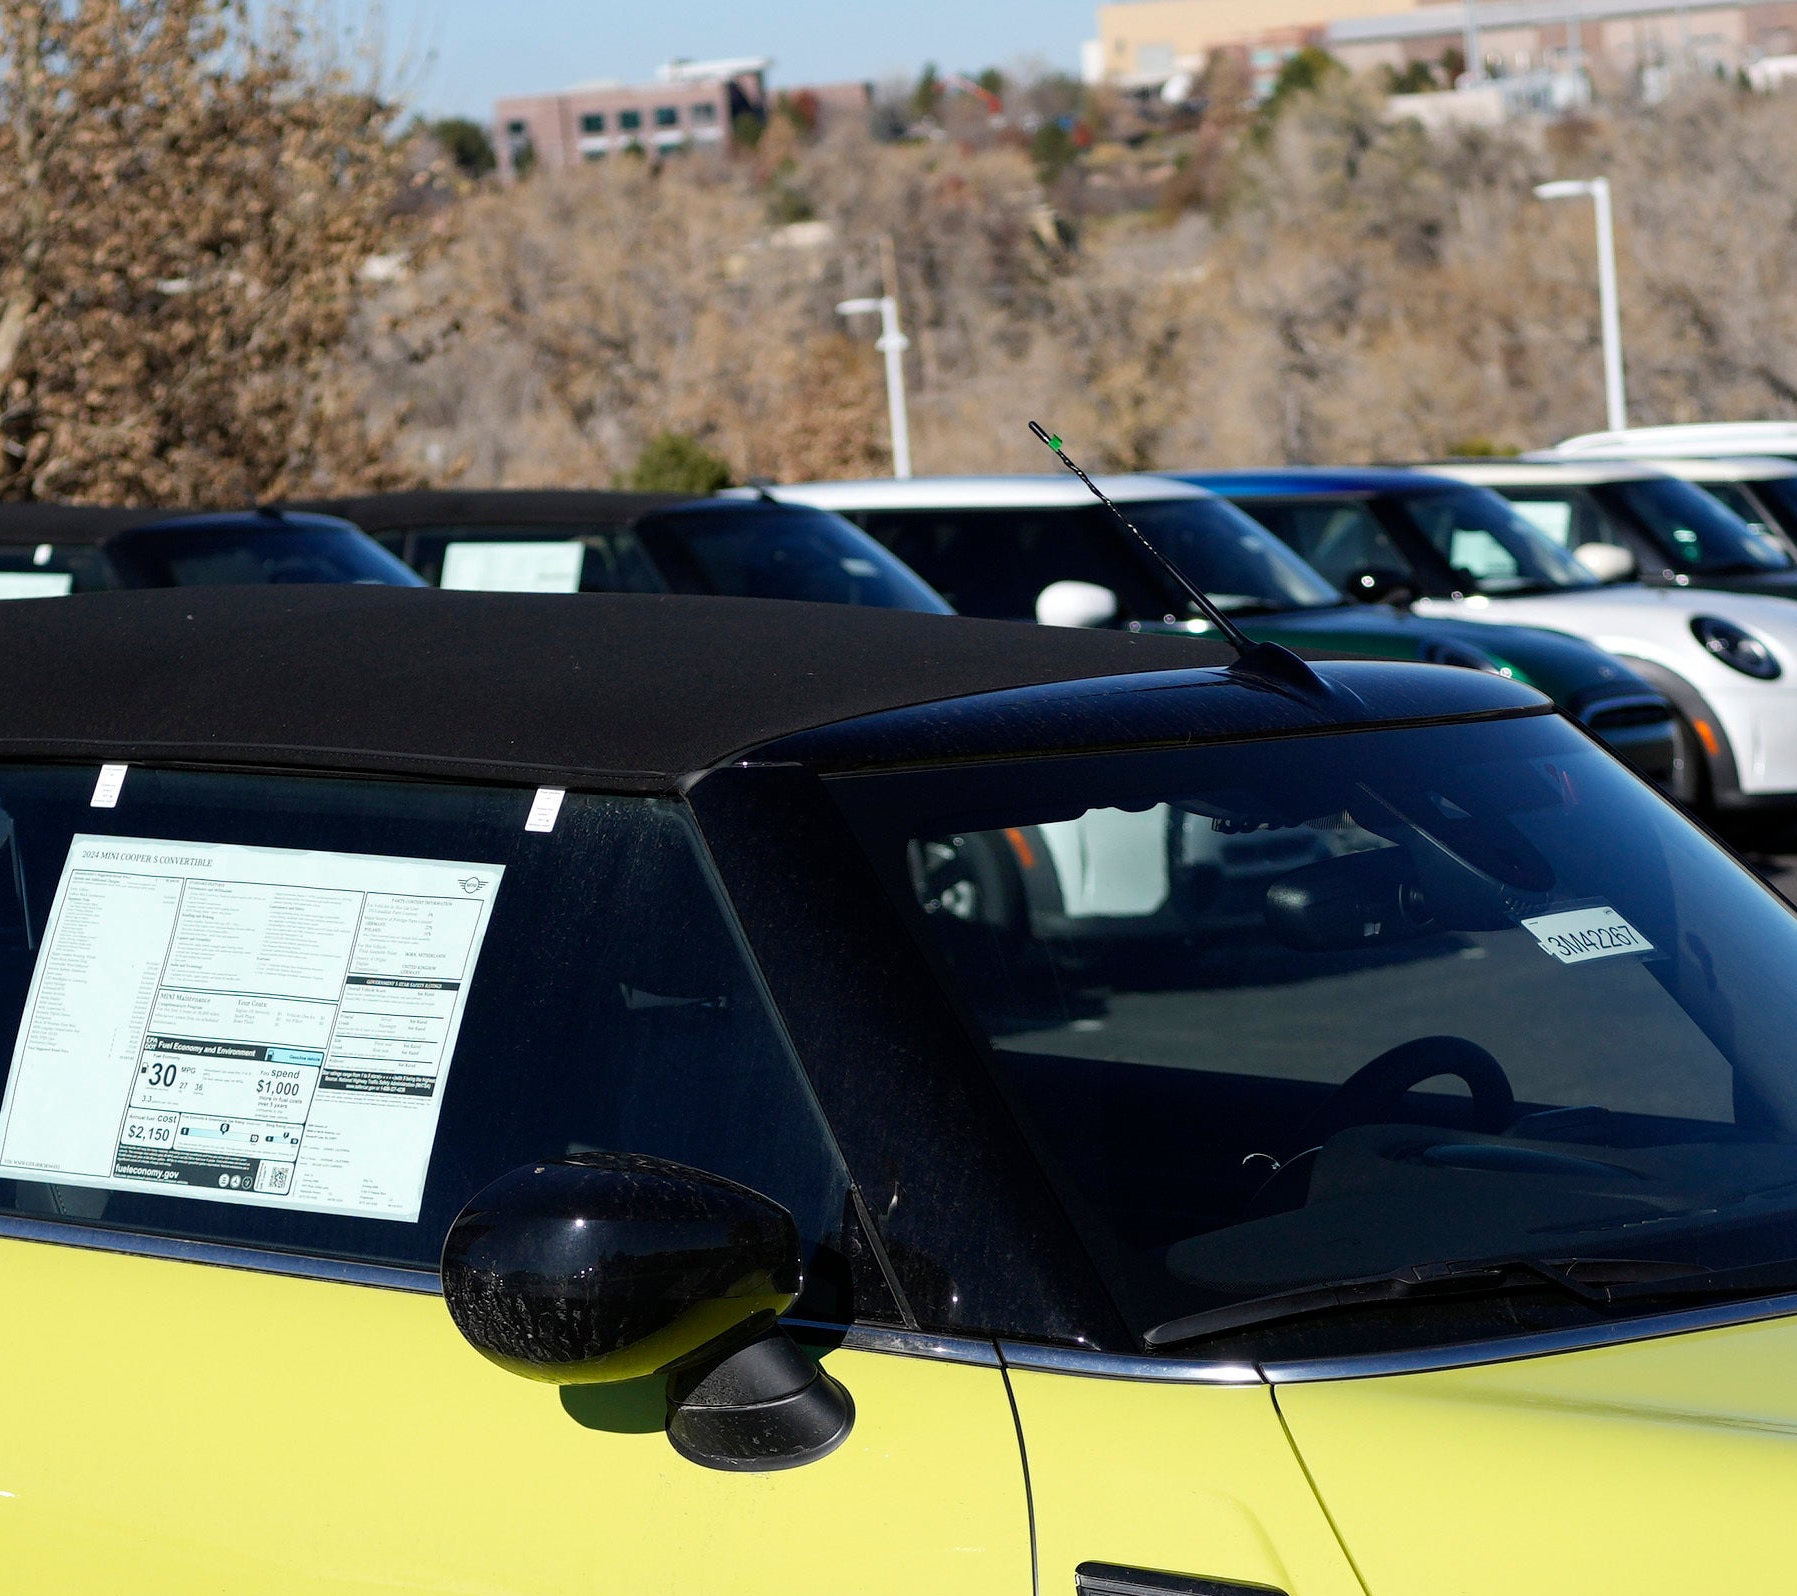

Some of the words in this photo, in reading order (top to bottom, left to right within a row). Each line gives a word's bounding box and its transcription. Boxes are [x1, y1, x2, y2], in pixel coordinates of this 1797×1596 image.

[82, 850, 100, 859] 2024
[100, 851, 121, 861] MINI
[121, 853, 152, 863] COOPER
[152, 855, 159, 864] S
[159, 855, 213, 868] CONVERTIBLE
[1548, 925, 1640, 956] 3M42267
[175, 994, 211, 1003] Maintenance
[157, 1040, 173, 1049] Fuel
[172, 1041, 203, 1053] Economy
[203, 1044, 216, 1053] and
[216, 1045, 256, 1057] Environment
[147, 1062, 178, 1087] 30
[180, 1066, 196, 1074] MPG
[269, 1068, 300, 1080] spend
[254, 1079, 300, 1097] $1,000
[156, 1113, 177, 1123] cost
[126, 1124, 171, 1142] $2,150
[116, 1163, 180, 1179] fueleconomy.gov
